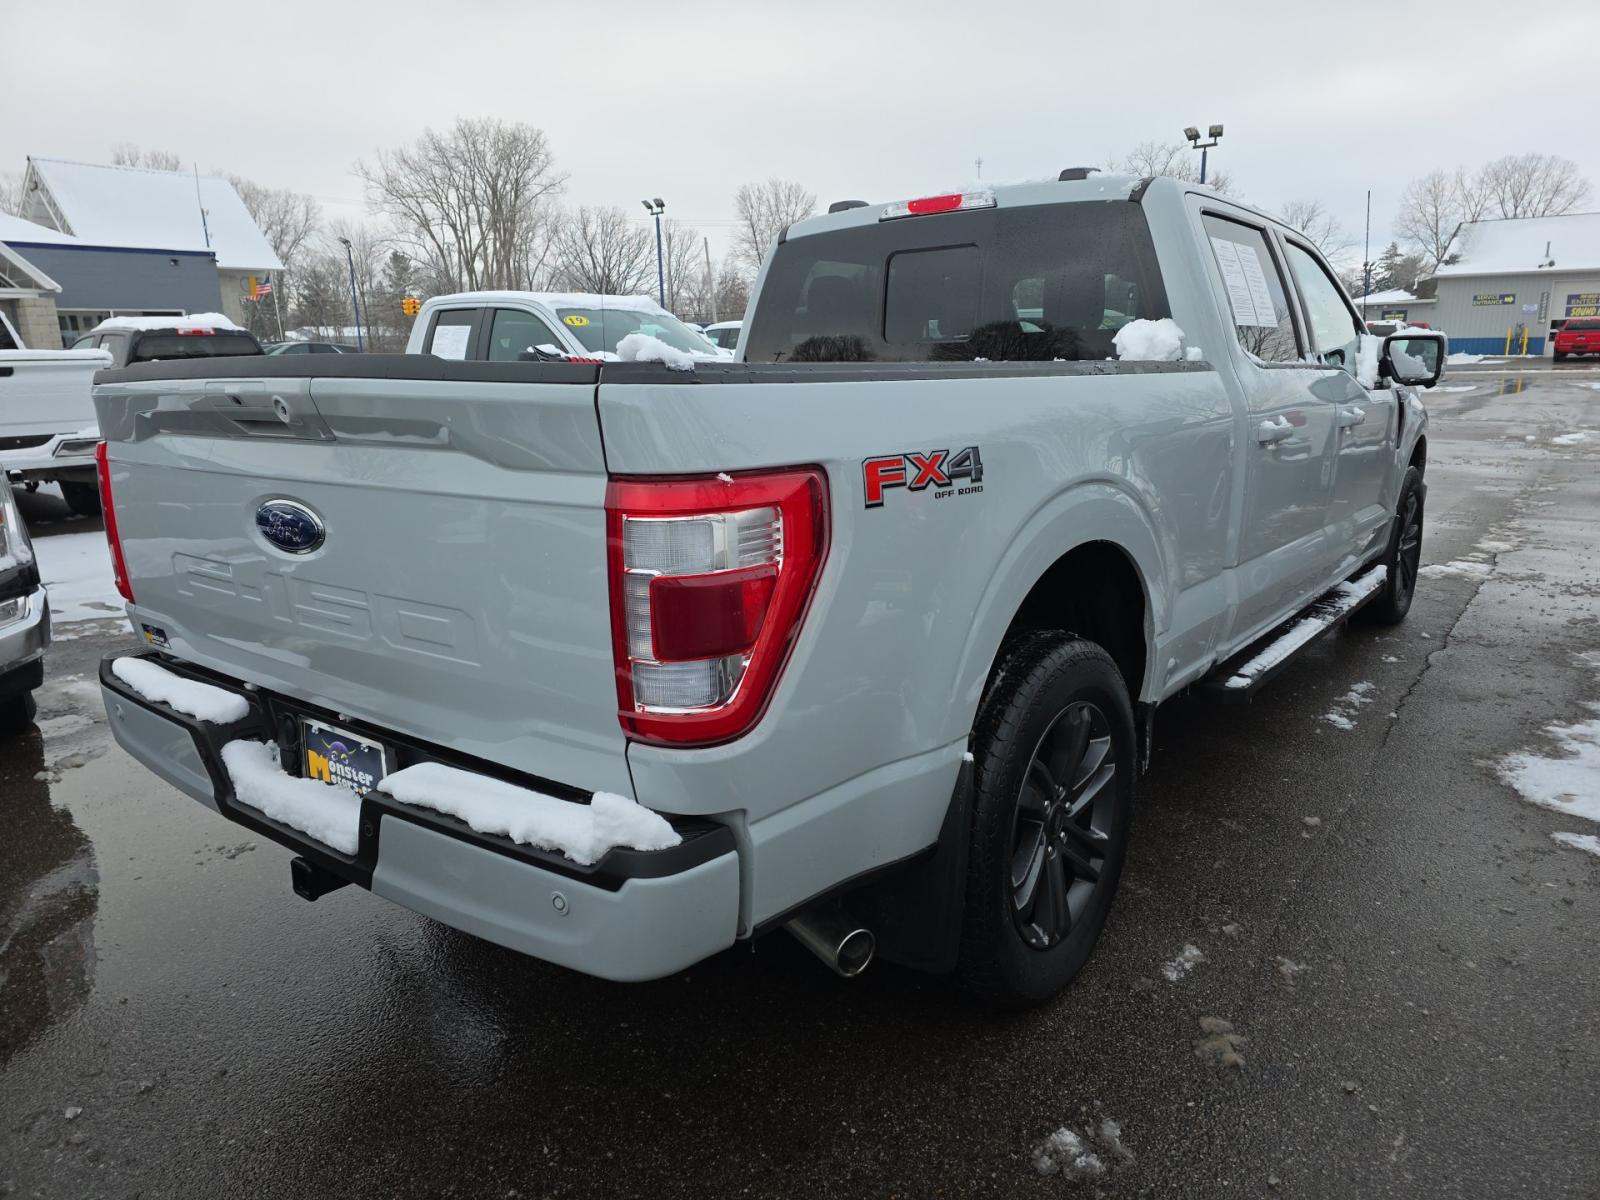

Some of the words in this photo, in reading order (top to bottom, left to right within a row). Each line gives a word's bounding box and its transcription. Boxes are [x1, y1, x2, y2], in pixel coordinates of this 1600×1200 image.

[1570, 306, 1597, 317] SOUND
[861, 446, 984, 509] FX4
[934, 490, 955, 500] OFF
[958, 485, 984, 496] ROAD
